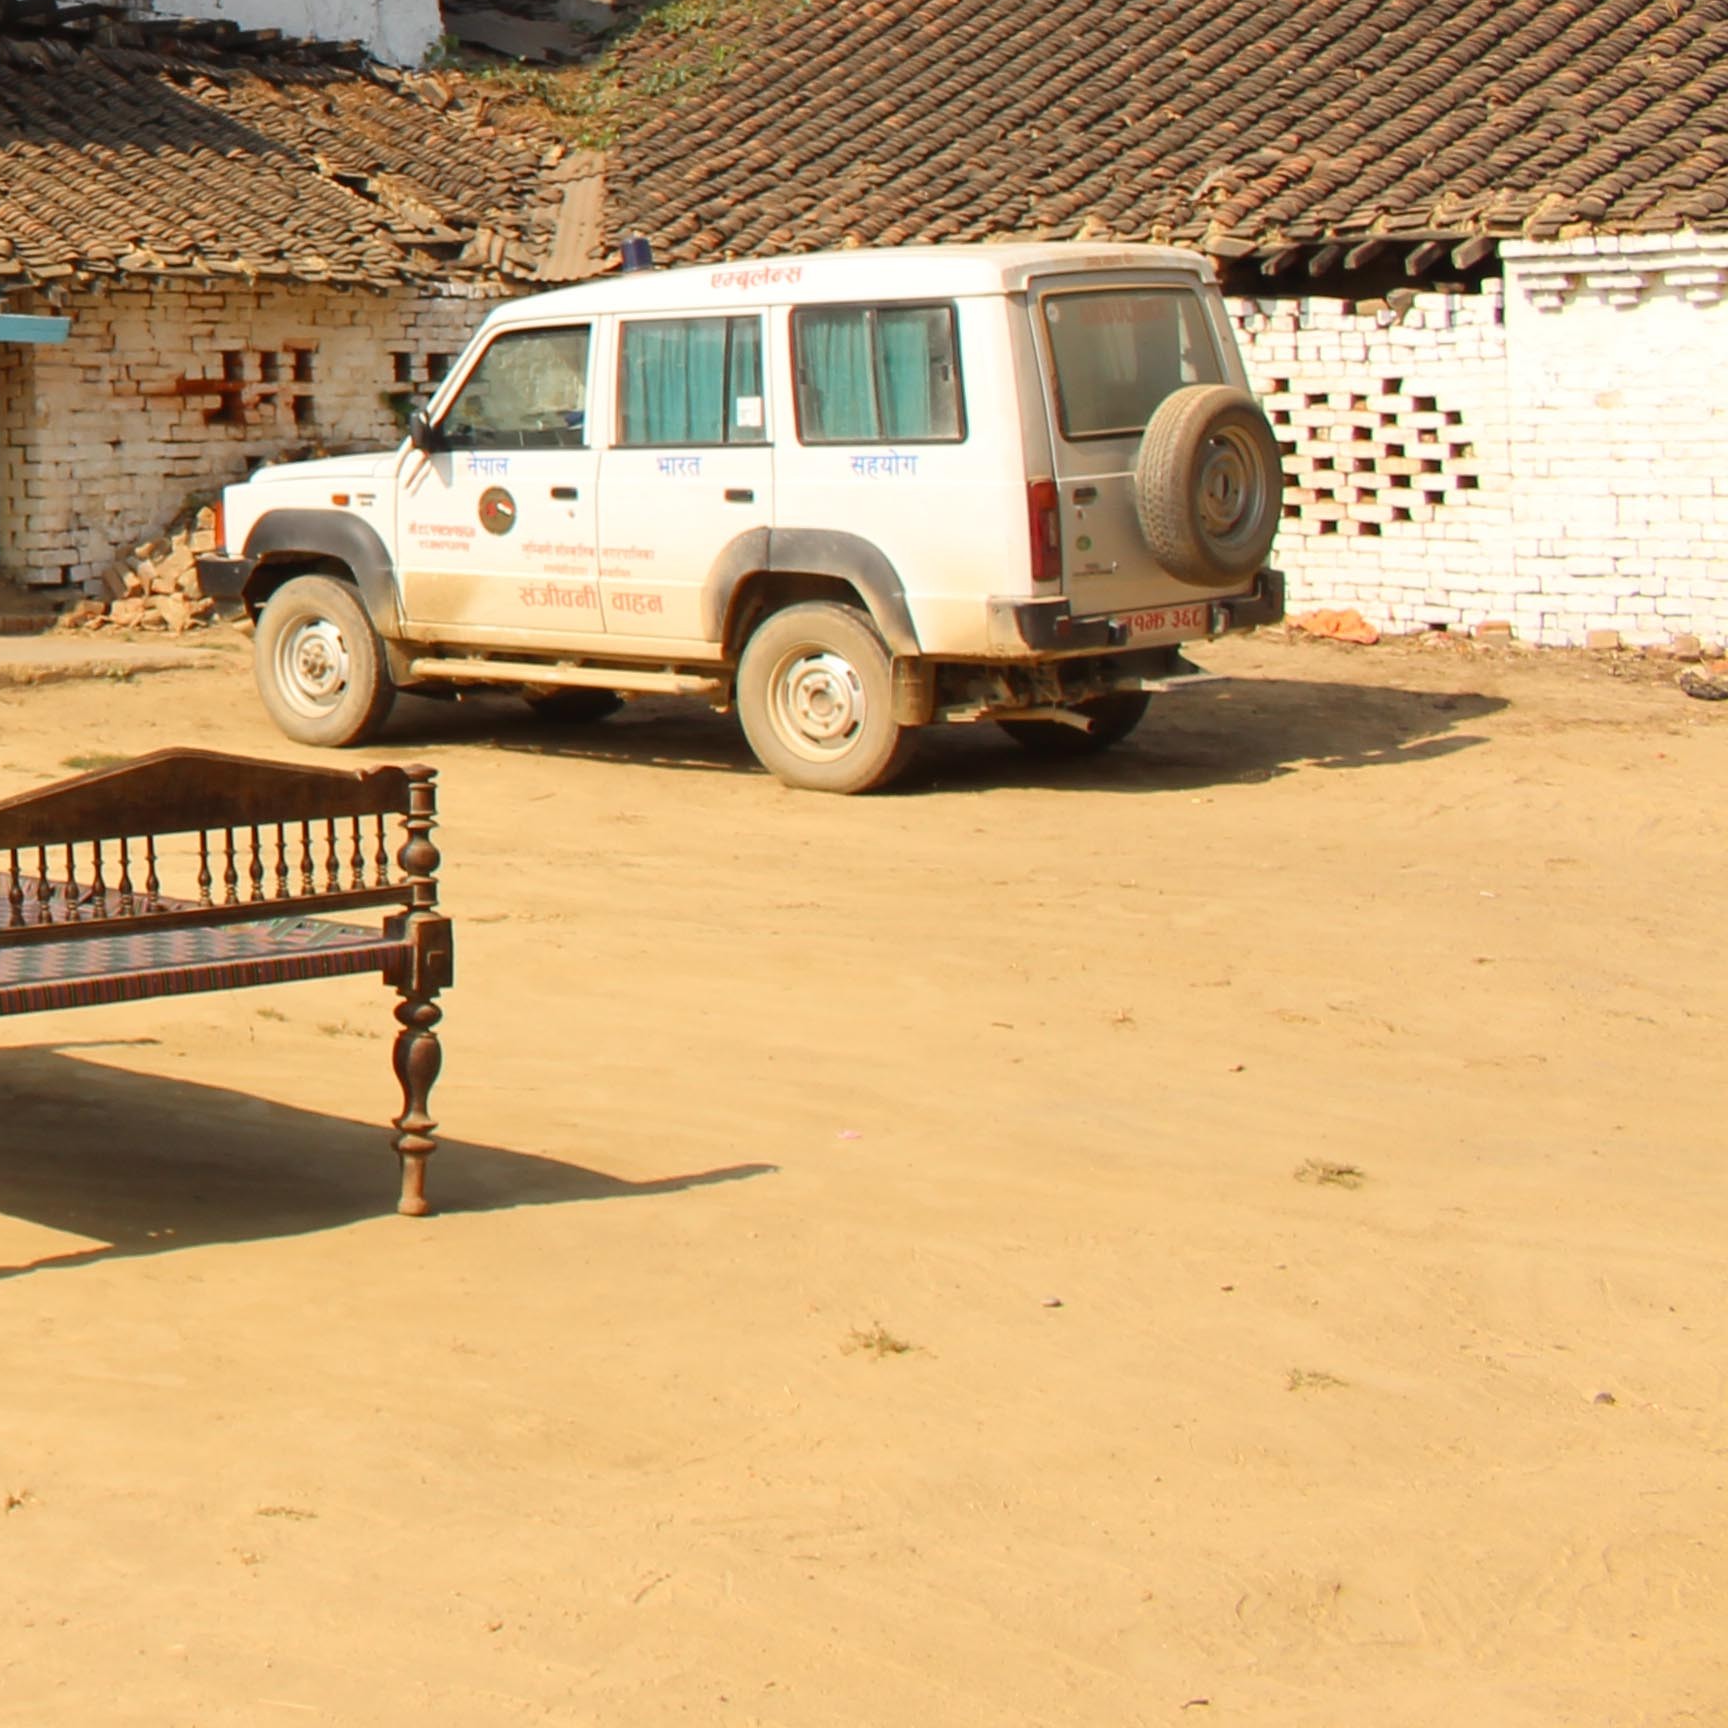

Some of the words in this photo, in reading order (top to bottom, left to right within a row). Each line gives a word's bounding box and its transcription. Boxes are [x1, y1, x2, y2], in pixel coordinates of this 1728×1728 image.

[466, 452, 510, 476] नेपाल
[656, 455, 702, 477] भारत
[849, 448, 919, 480] सहयोग
[519, 582, 597, 609] संजीवनी
[611, 591, 664, 614] वाहन
